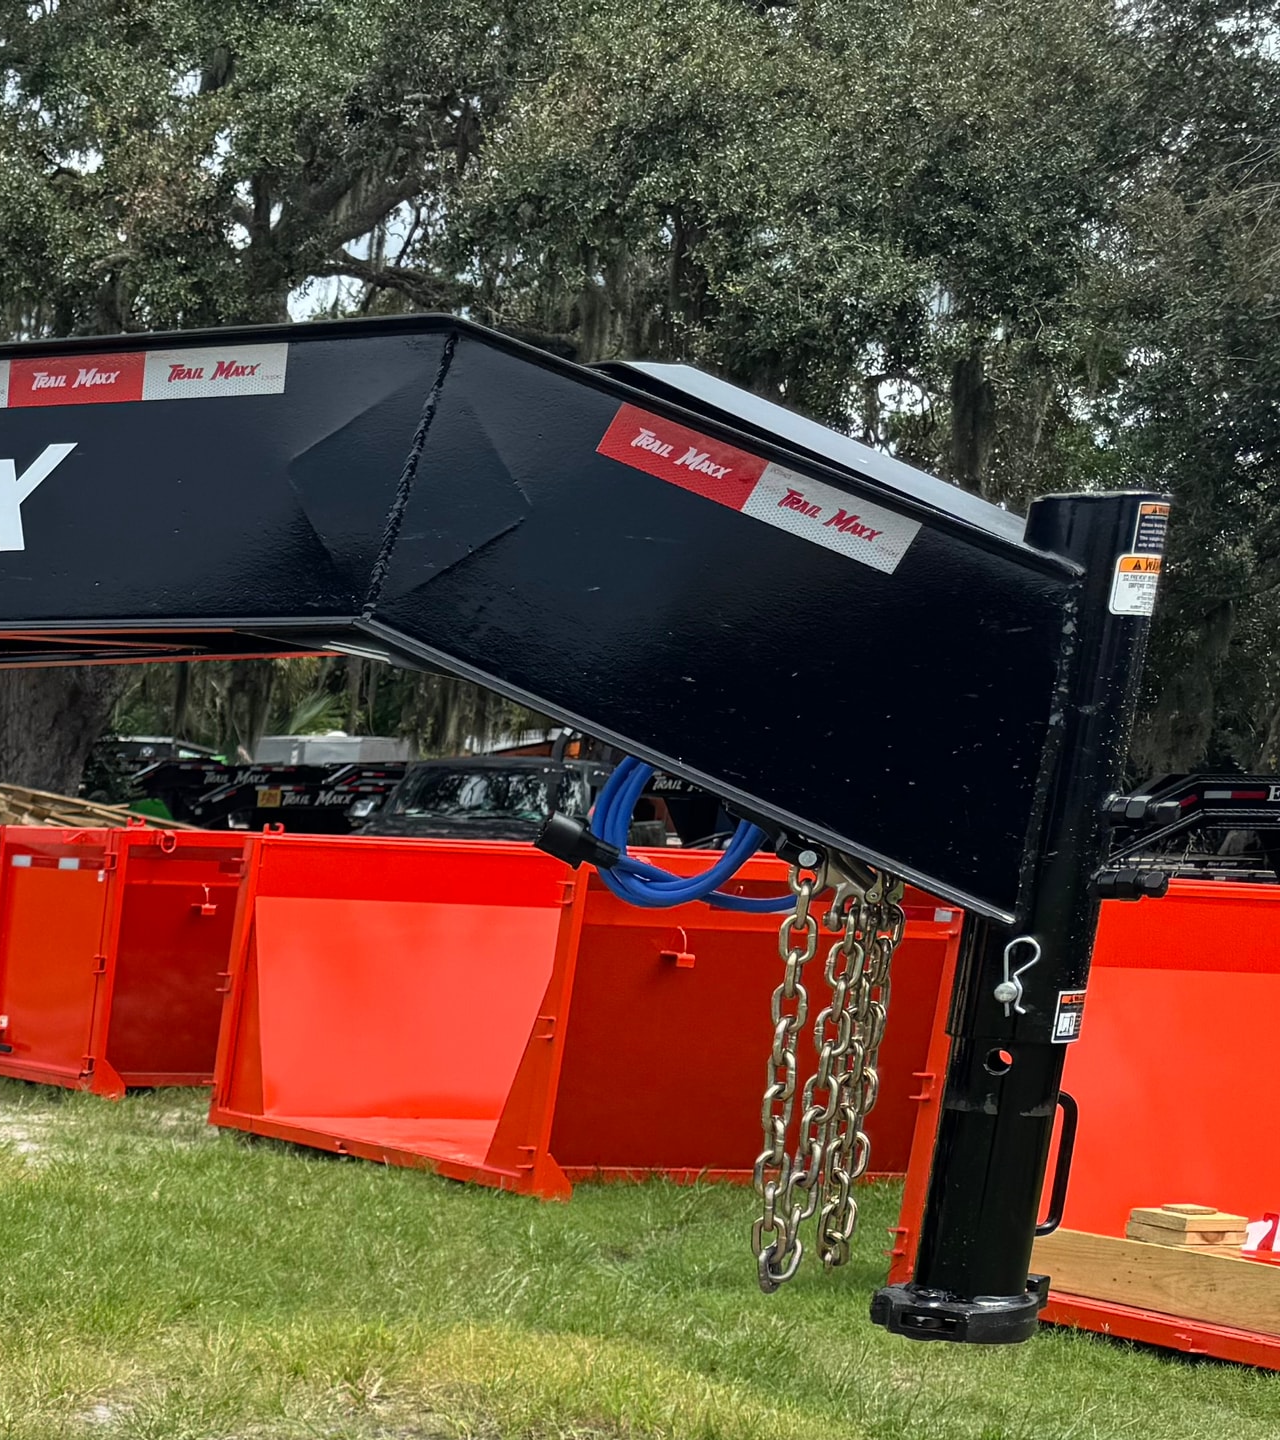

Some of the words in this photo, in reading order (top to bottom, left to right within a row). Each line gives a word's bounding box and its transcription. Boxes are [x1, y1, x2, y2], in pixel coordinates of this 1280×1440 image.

[31, 372, 66, 390] TRAIL
[72, 368, 121, 388] MAXX
[167, 363, 204, 382] TRAIL
[209, 360, 261, 381] MAXX
[630, 427, 671, 457] TRAIL
[673, 446, 733, 479] MAXX
[777, 487, 822, 519] TRAIL
[826, 508, 883, 542] MAXX
